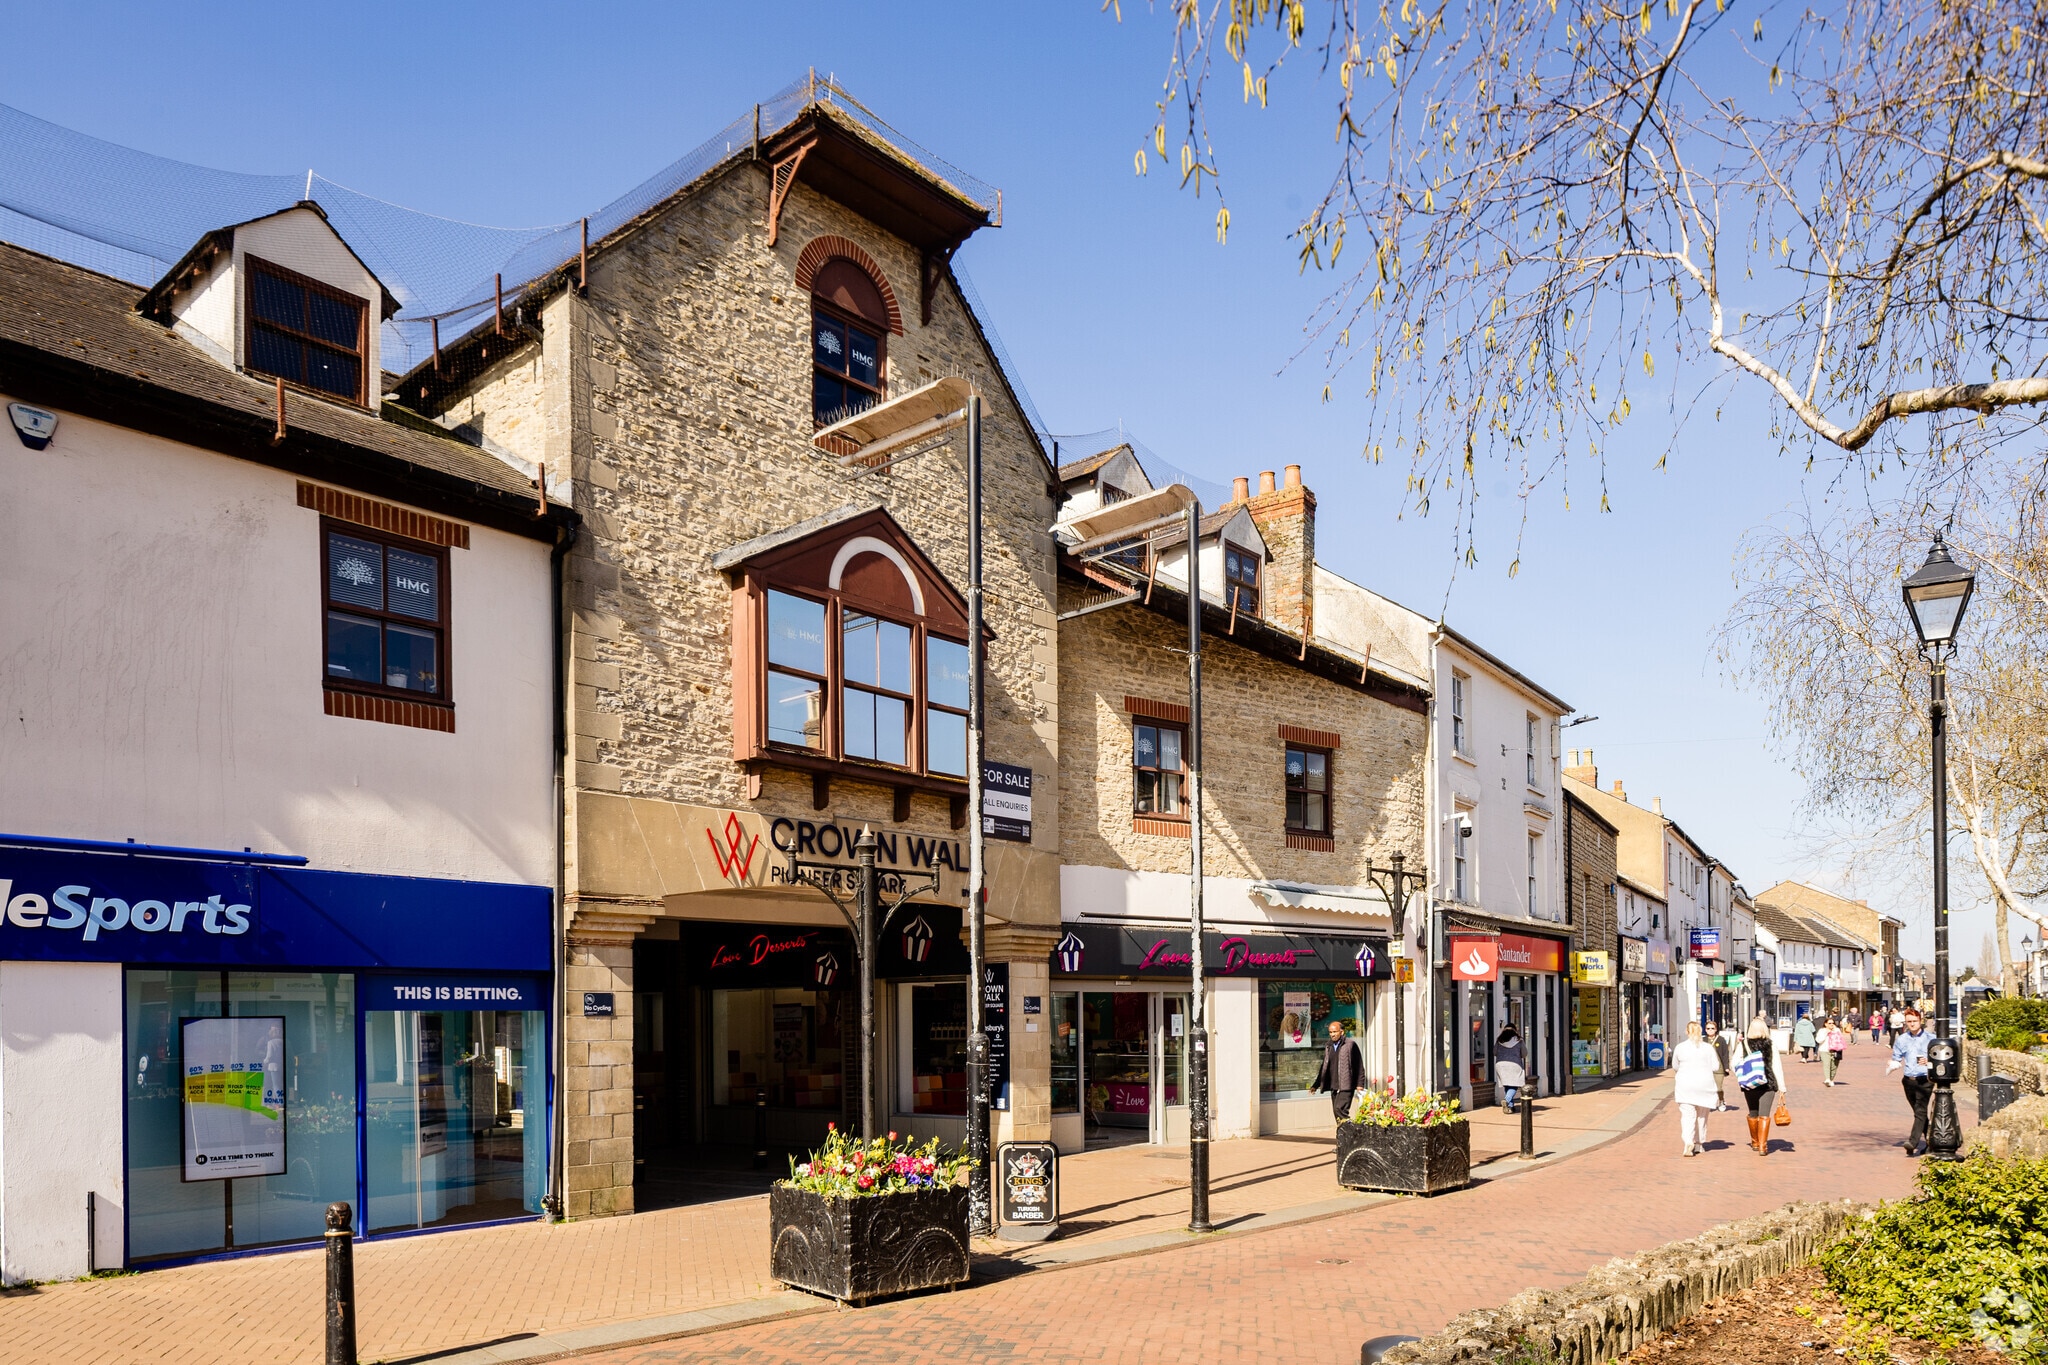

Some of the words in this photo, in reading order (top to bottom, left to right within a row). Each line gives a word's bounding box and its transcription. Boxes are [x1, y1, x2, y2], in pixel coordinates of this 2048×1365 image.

[852, 349, 873, 366] HMG
[396, 576, 430, 594] HMG
[799, 629, 822, 644] HMG
[1005, 772, 1030, 788] SALE
[984, 798, 996, 807] ALL
[996, 800, 1028, 812] ENQUIRIES
[770, 817, 897, 864] CROWN
[906, 836, 987, 875] WAL
[846, 873, 907, 895] SARE
[710, 945, 741, 970] Love
[748, 932, 820, 965] Desserts
[1138, 939, 1192, 971] Love
[1215, 937, 1315, 975] Desserts
[1498, 943, 1531, 964] Santander
[1580, 962, 1604, 970] Works
[394, 986, 432, 1000] THIS
[435, 987, 450, 1000] IS
[454, 988, 522, 1000] BETTING.
[985, 985, 1004, 993] OWN
[984, 993, 1000, 1001] ALK
[1126, 1092, 1145, 1106] Love
[1014, 1177, 1043, 1185] KINGS
